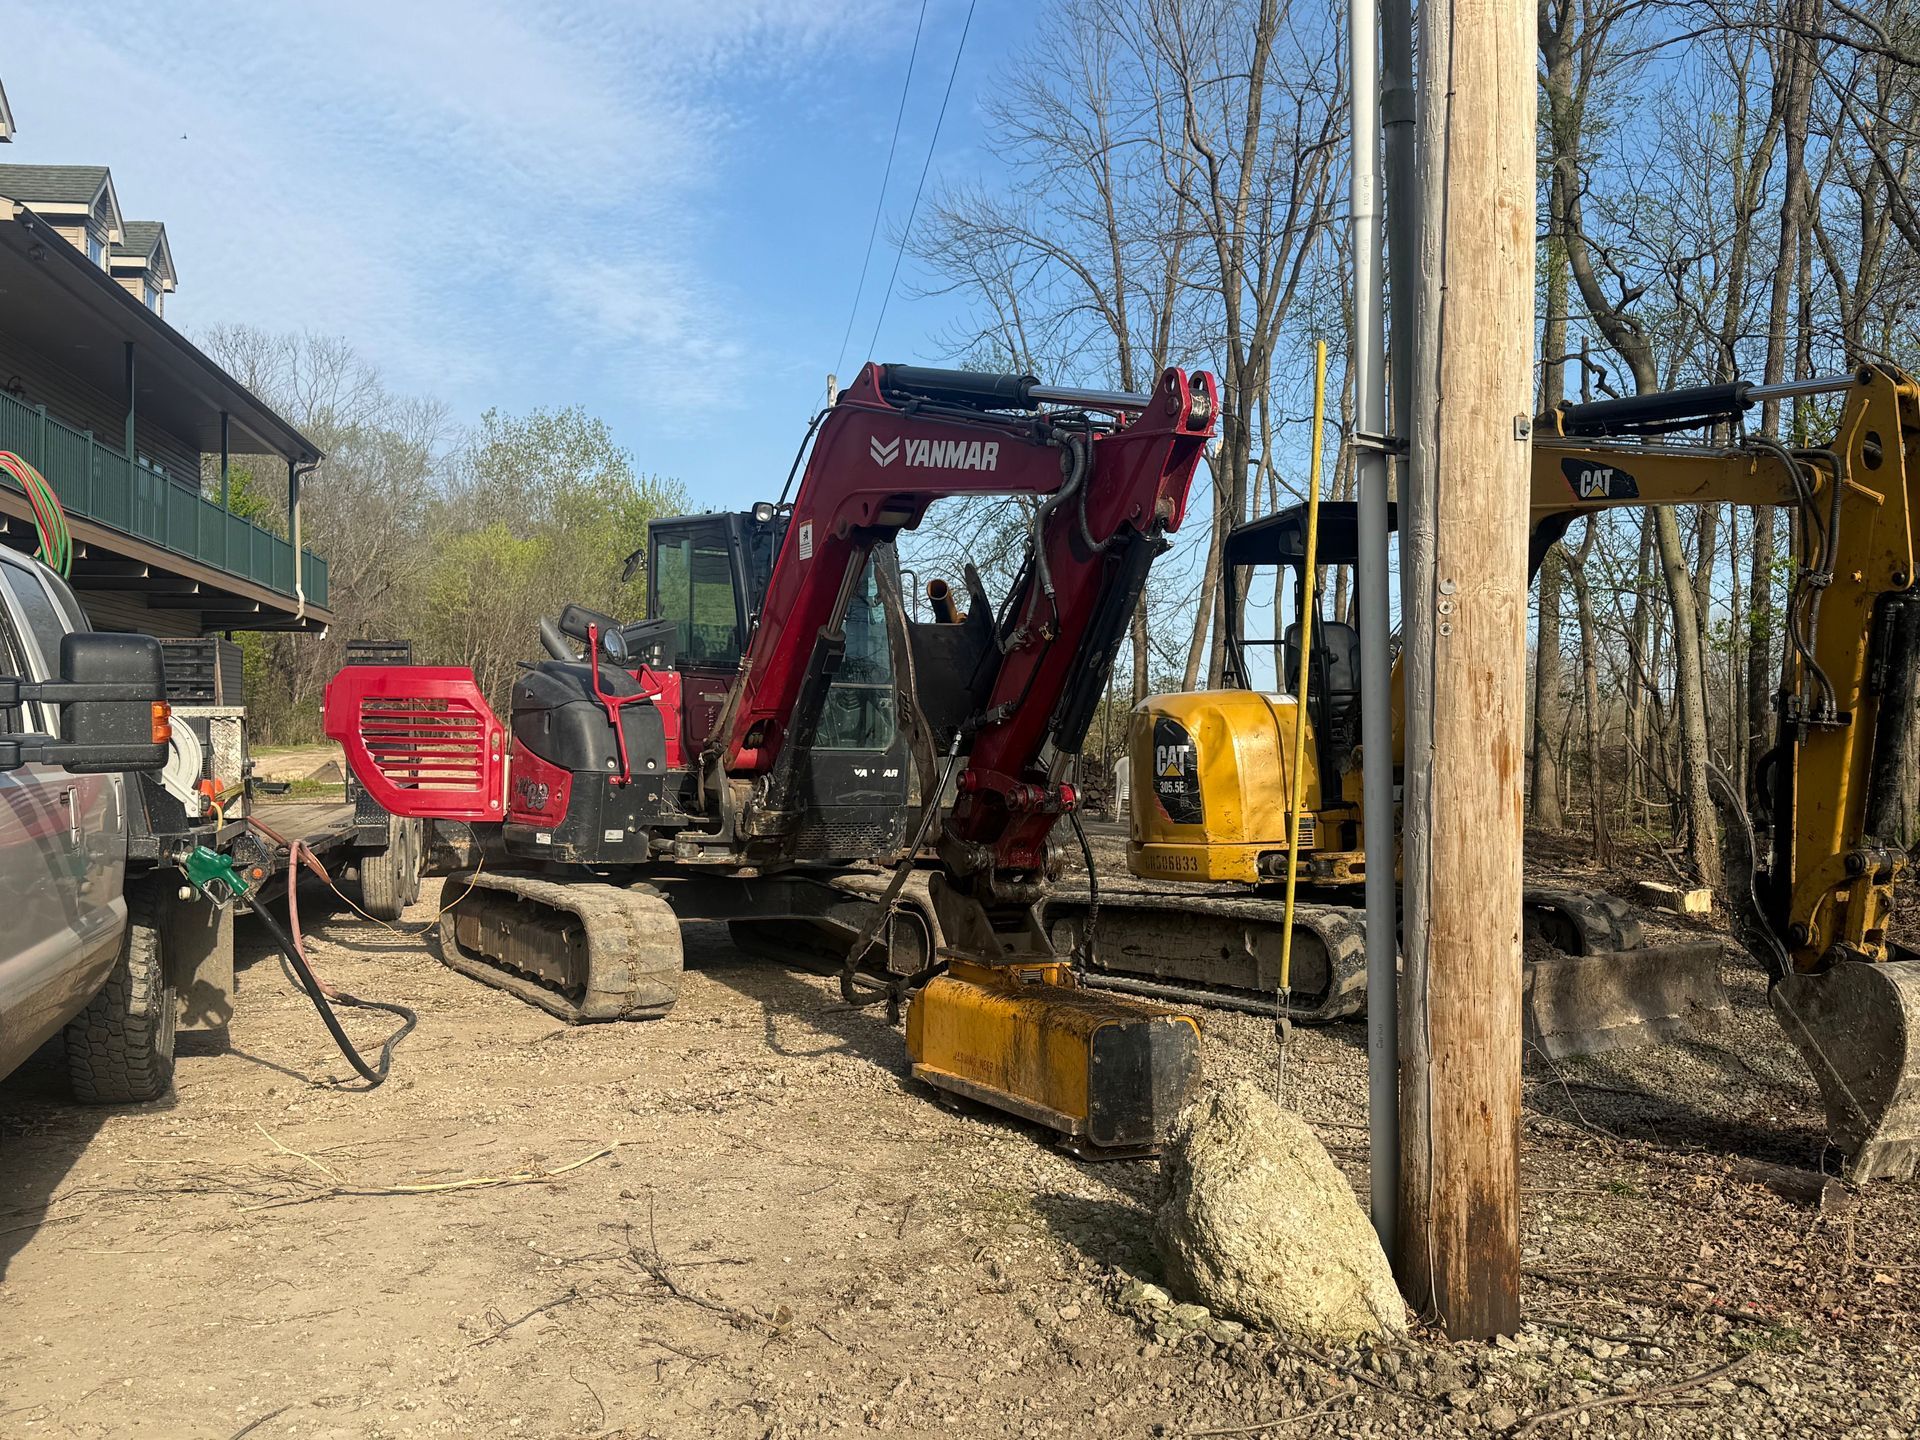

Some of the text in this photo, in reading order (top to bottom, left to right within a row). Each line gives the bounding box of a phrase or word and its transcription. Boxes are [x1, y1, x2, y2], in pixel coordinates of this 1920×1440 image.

[904, 439, 1000, 471] YANMAR
[1580, 468, 1614, 498] CAT
[1156, 745, 1190, 777] CAT
